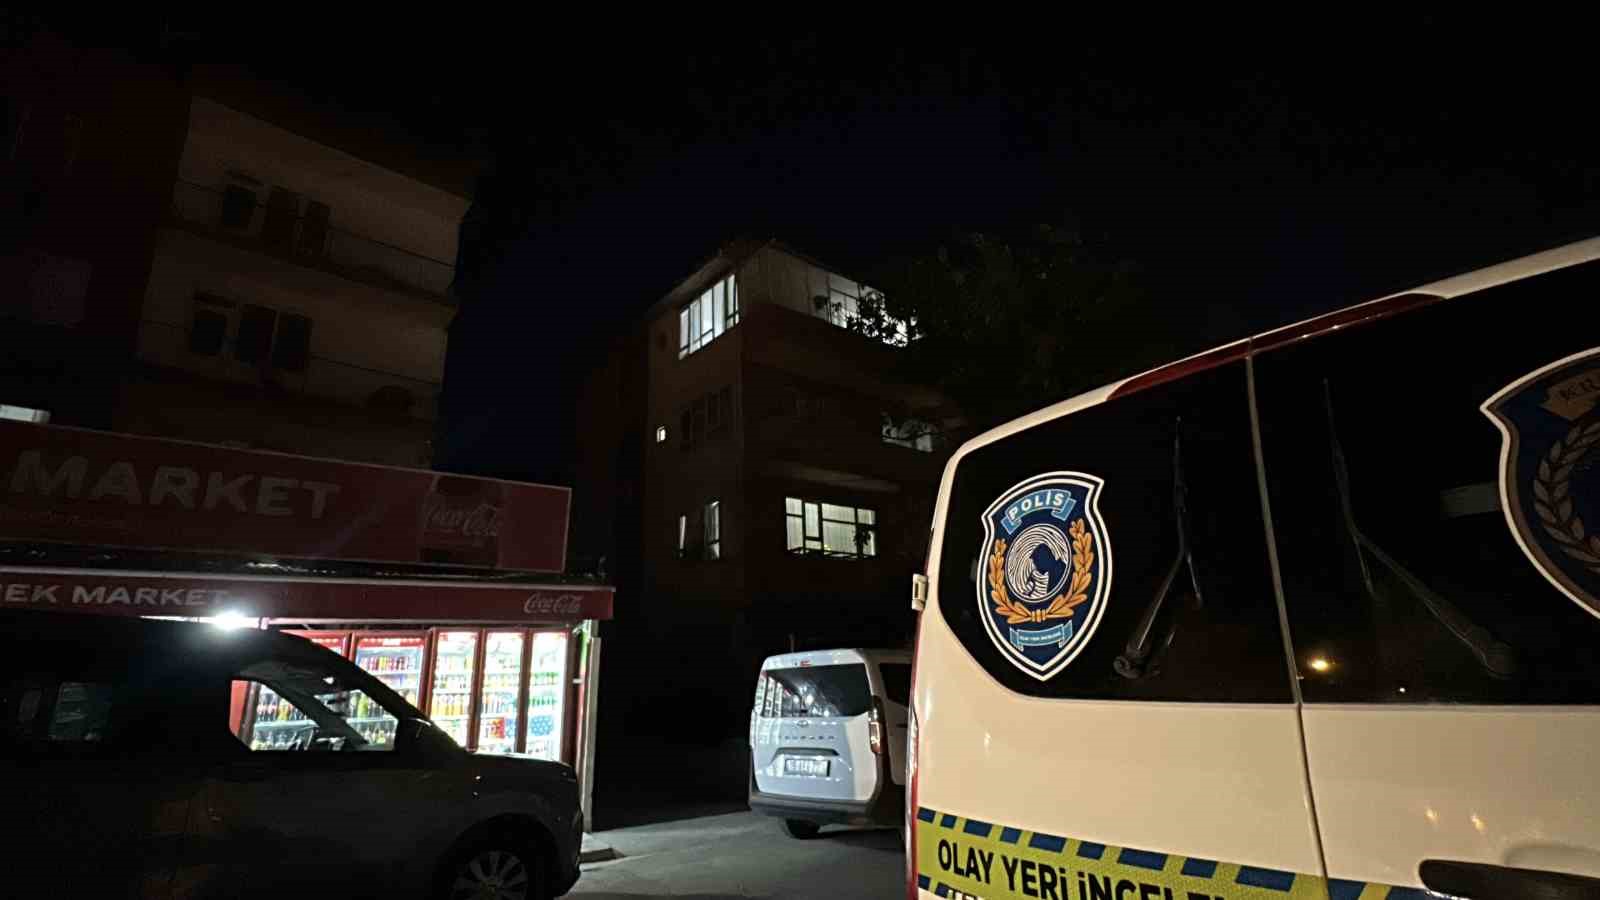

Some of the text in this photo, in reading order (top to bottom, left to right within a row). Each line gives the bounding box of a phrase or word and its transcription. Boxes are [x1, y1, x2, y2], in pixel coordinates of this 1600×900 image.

[8, 449, 342, 520] MARKET
[0, 583, 232, 606] EK MARKET
[937, 839, 994, 884] OLAY
